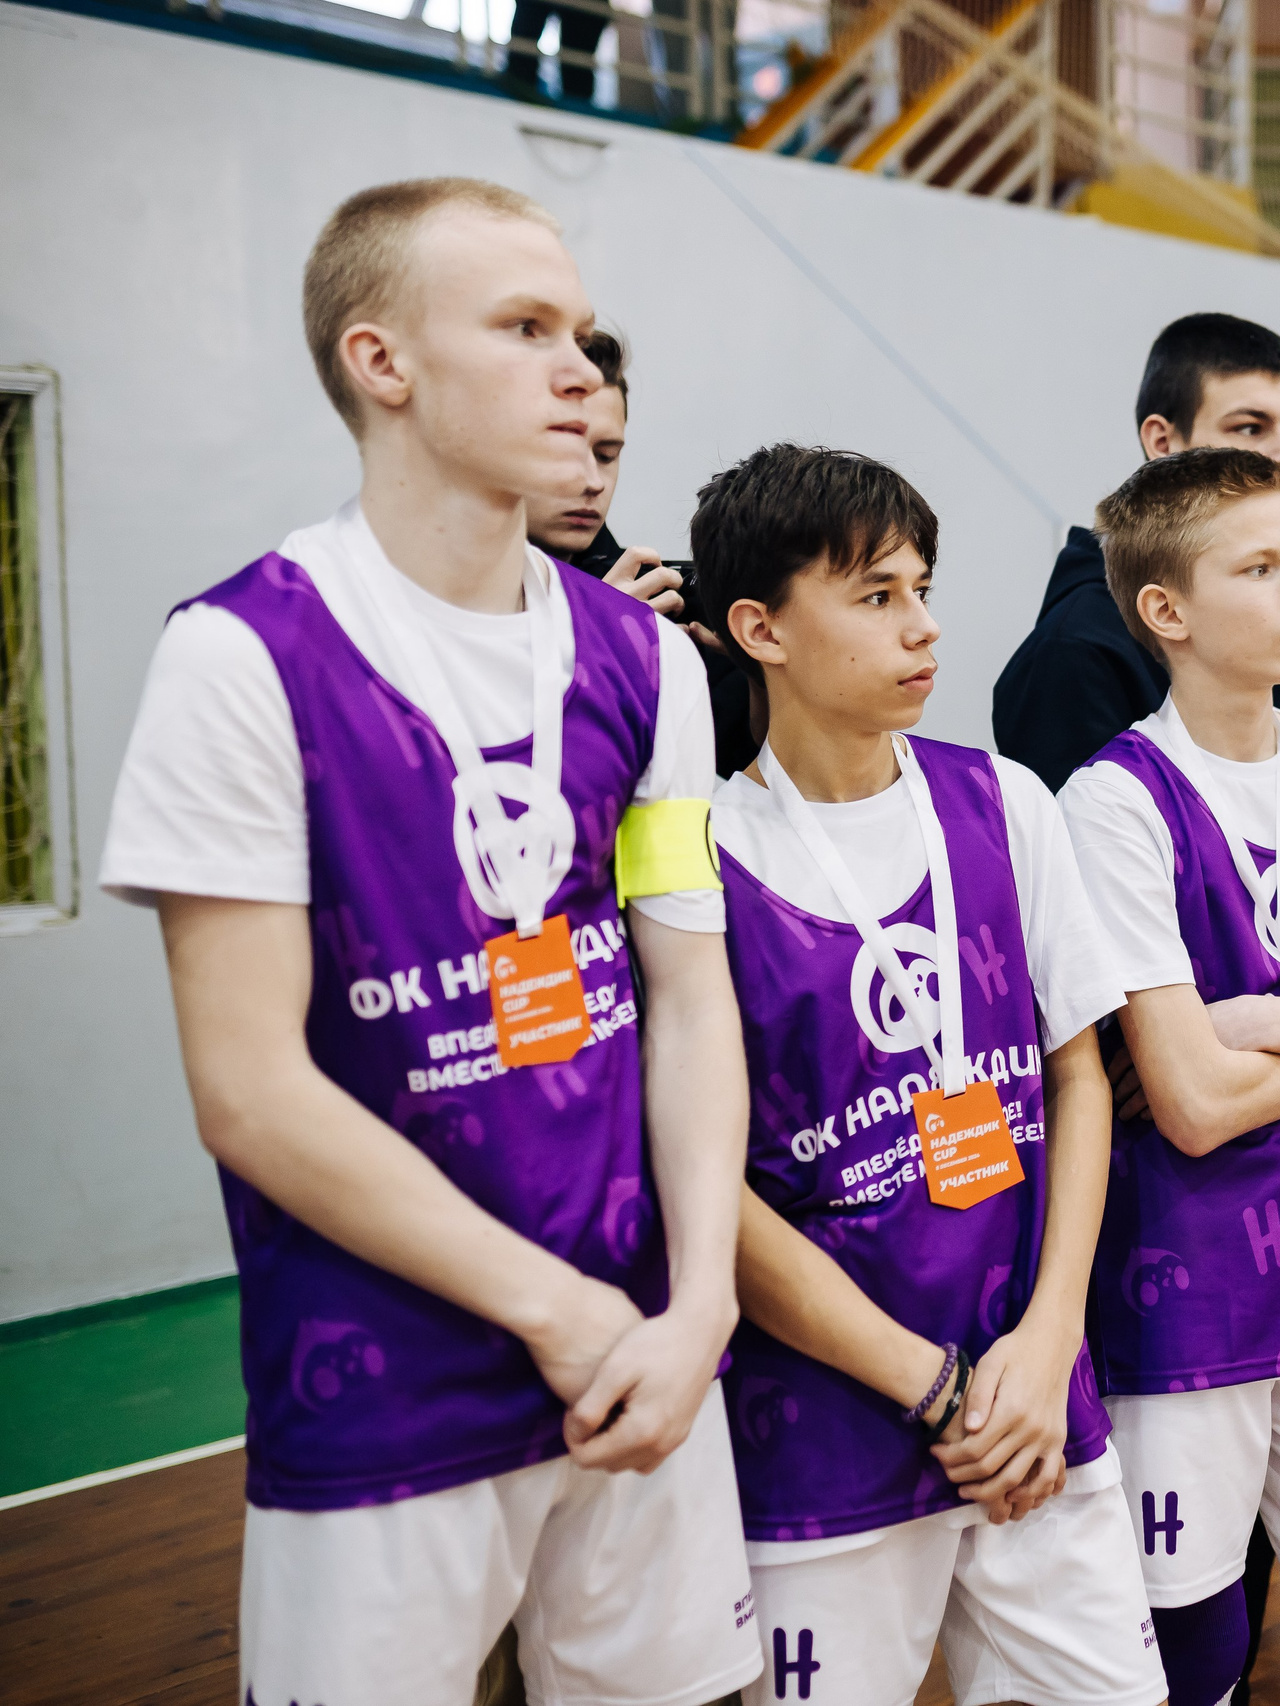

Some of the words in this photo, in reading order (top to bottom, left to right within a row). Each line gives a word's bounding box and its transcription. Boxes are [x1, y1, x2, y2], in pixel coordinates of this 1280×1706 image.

[349, 966, 432, 1020] ФК
[930, 1120, 1000, 1149] НАДЕЖДИК
[841, 1135, 922, 1188] ВПЕРЁД
[933, 1146, 957, 1162] CUP
[829, 1162, 917, 1206] МЕСТЕ
[940, 1160, 1009, 1192] УЧАСТНИК
